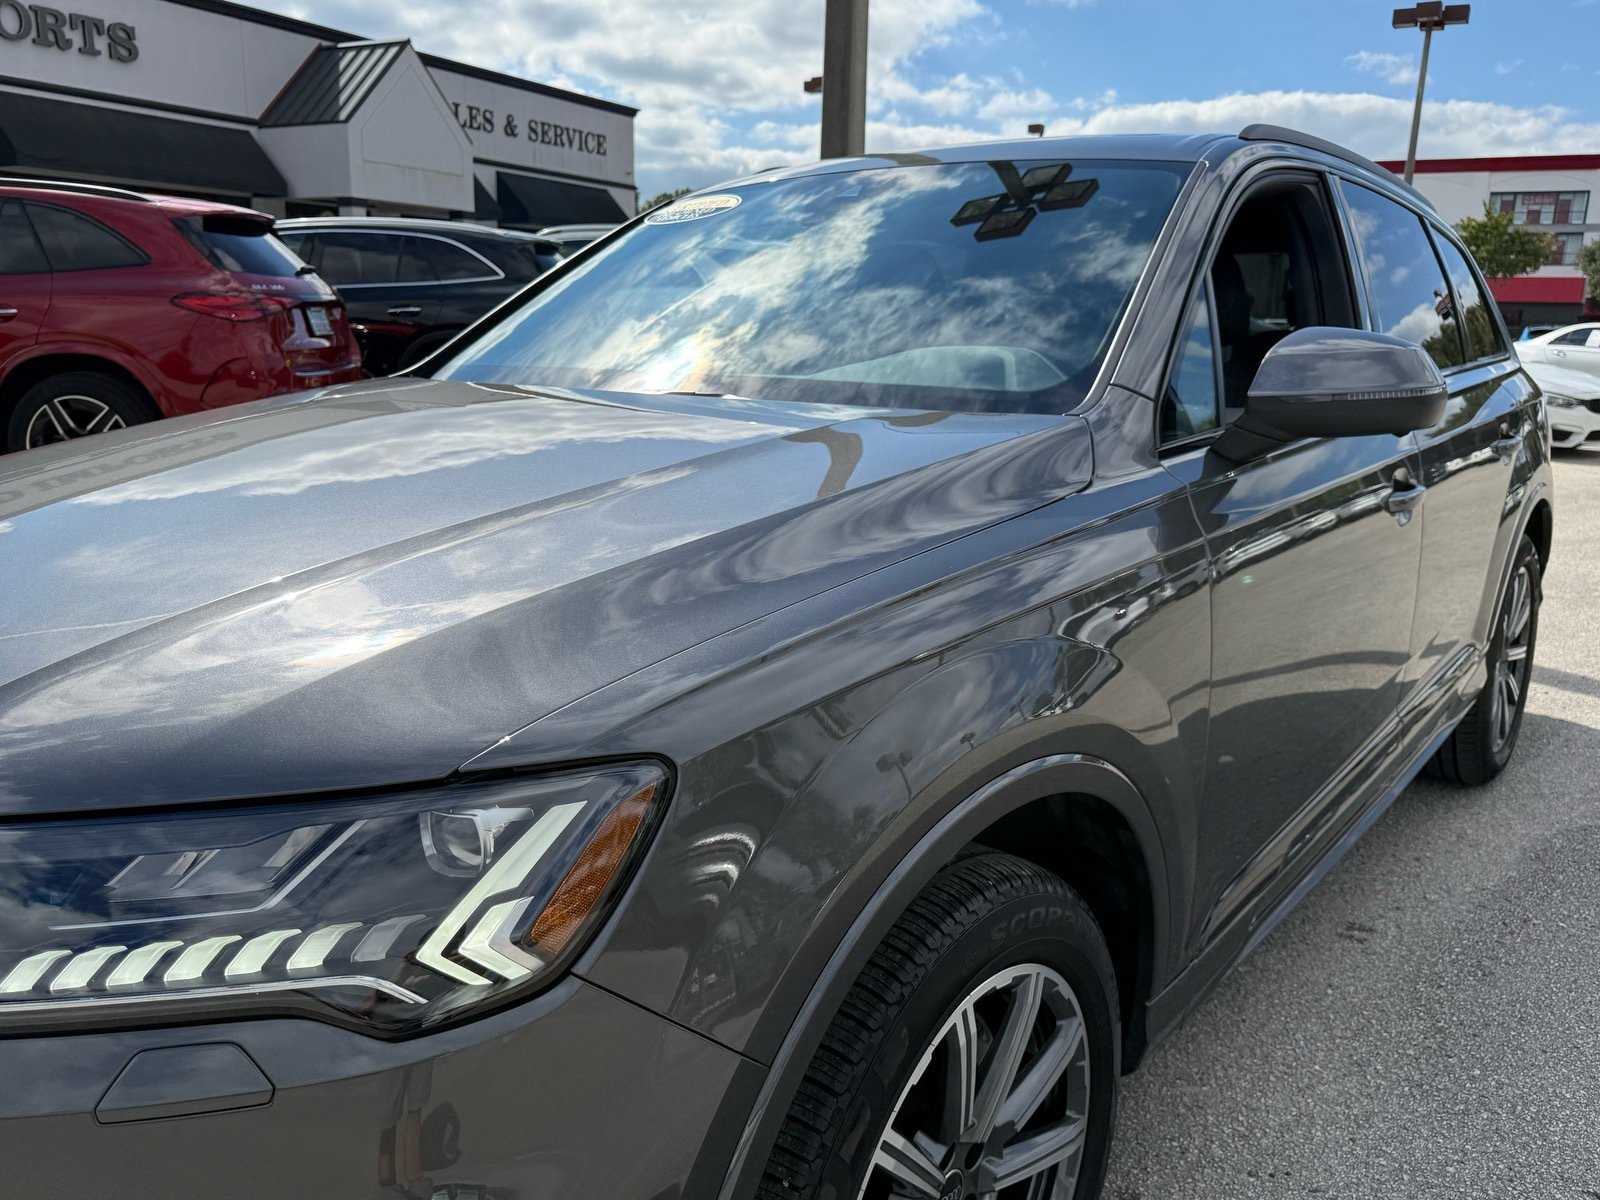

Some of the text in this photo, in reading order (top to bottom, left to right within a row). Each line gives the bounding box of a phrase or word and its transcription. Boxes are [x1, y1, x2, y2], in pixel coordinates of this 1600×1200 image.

[0, 0, 139, 63] ORTS
[503, 113, 518, 138] &
[527, 119, 607, 156] SERVICE
